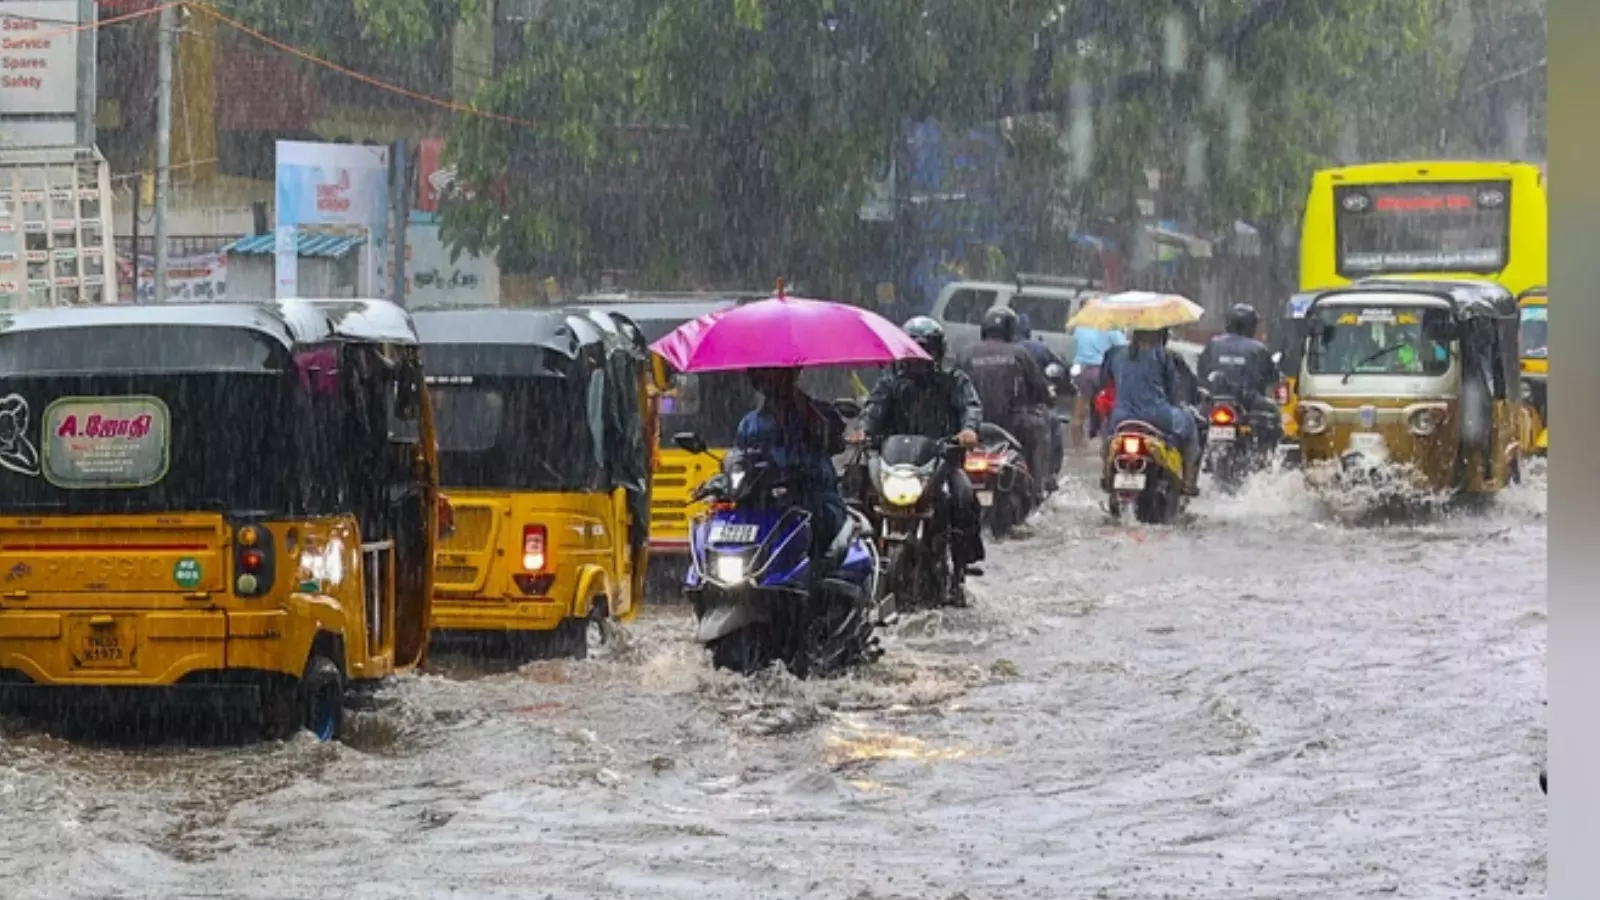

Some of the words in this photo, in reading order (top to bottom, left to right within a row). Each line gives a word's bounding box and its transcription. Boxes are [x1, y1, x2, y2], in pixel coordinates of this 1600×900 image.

[3, 19, 38, 30] Sales
[3, 38, 51, 49] Service
[3, 57, 47, 70] Spares
[2, 75, 42, 89] Safety
[44, 556, 166, 579] PIAGGIO
